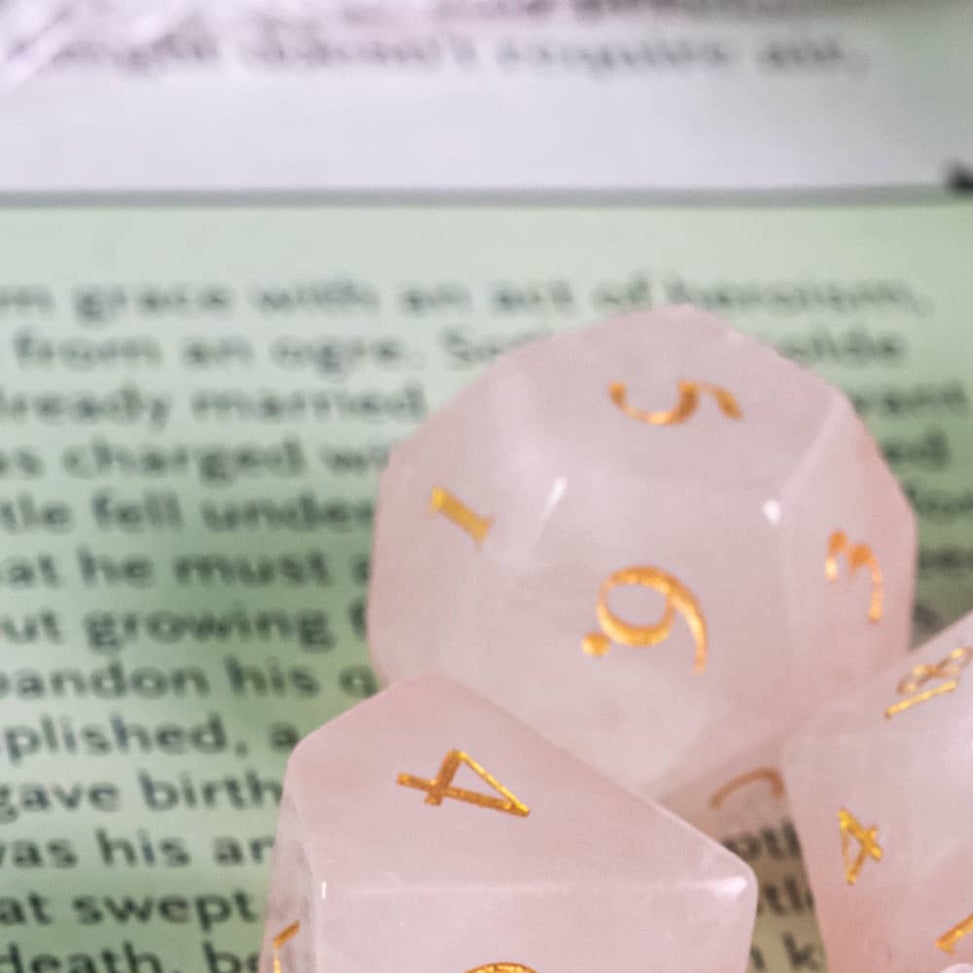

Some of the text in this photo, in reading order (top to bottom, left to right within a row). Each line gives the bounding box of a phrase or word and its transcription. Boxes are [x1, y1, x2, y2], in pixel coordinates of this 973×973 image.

[13, 327, 163, 371] from
[182, 335, 255, 370] an
[192, 378, 429, 424] married
[609, 380, 743, 425] 5
[62, 437, 306, 488] charged
[92, 488, 184, 532] fell
[76, 545, 152, 588] he
[173, 548, 333, 588] must
[83, 598, 337, 654] growing
[222, 654, 321, 699] his
[137, 768, 285, 812] birth
[396, 748, 530, 817] 4
[0, 836, 78, 869] as
[95, 826, 191, 868] his
[839, 807, 883, 885] 4
[72, 888, 258, 933] swept
